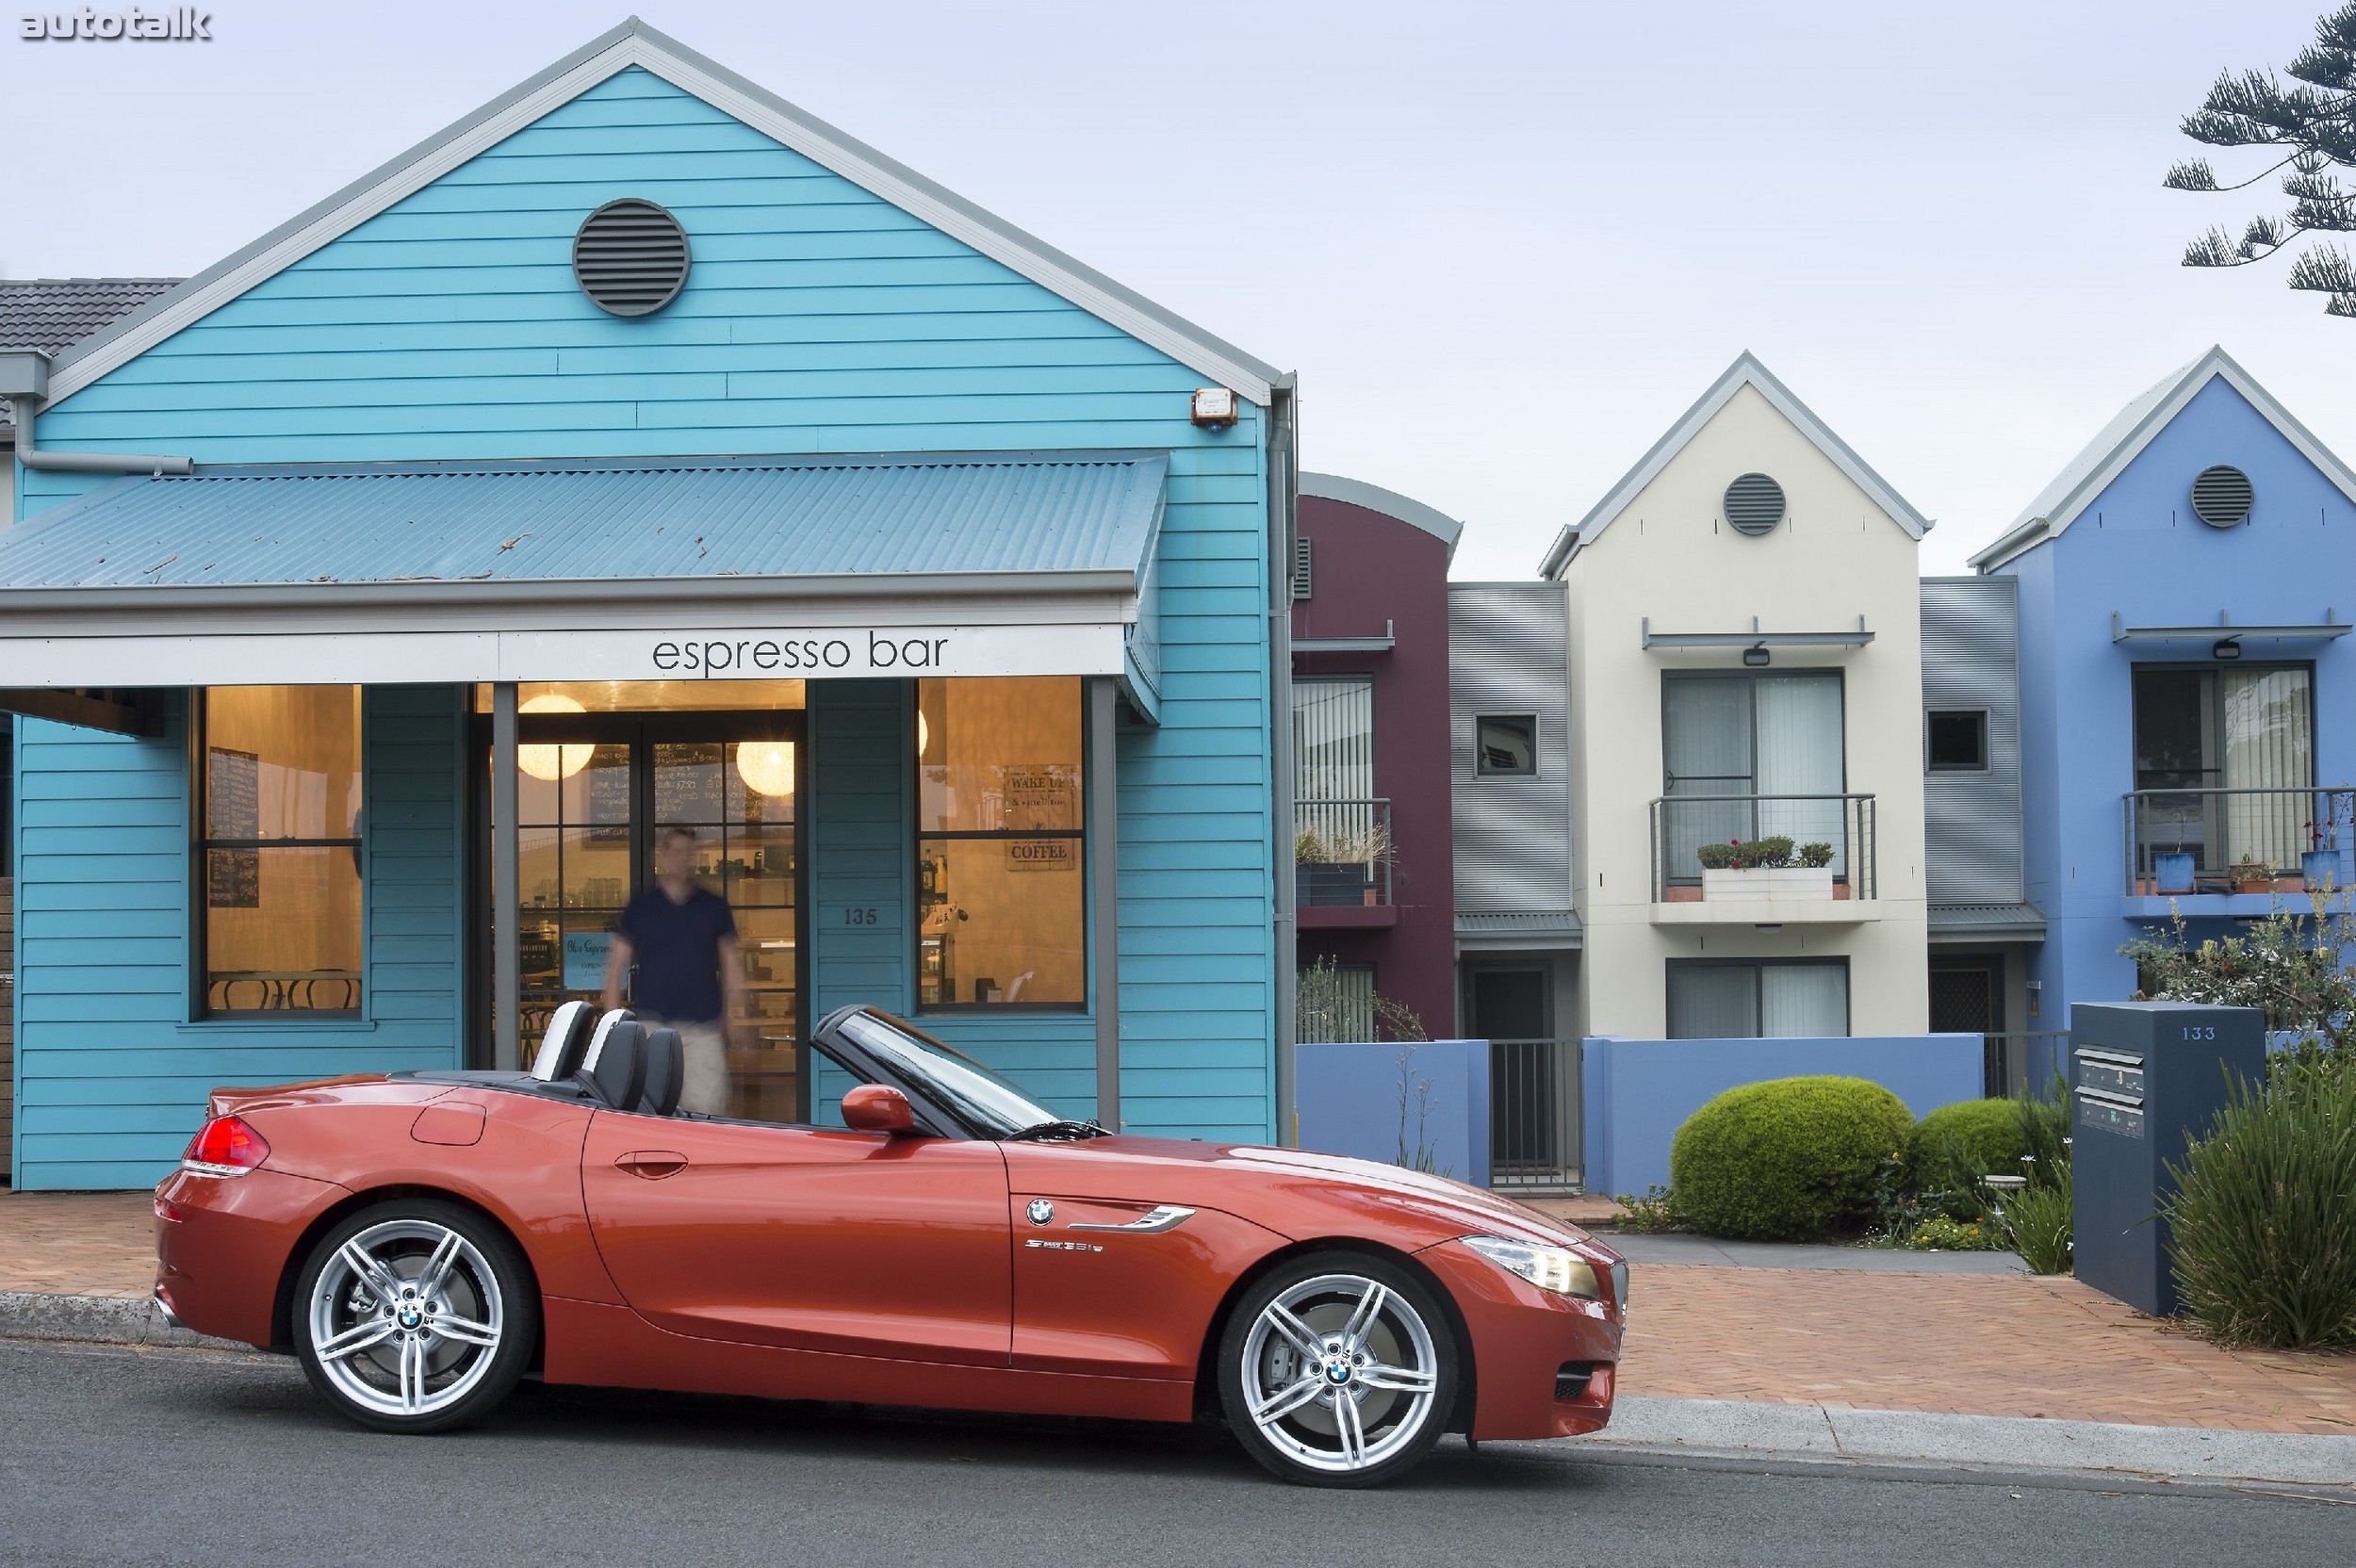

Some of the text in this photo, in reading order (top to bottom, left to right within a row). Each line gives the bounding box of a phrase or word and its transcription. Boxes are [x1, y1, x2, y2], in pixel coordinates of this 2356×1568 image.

[652, 630, 949, 678] espresso bar
[1011, 777, 1066, 789] WAKE UP
[1012, 798, 1019, 807] &
[1011, 845, 1067, 858] COFFEE
[844, 908, 876, 924] 135
[2183, 1027, 2215, 1040] 133
